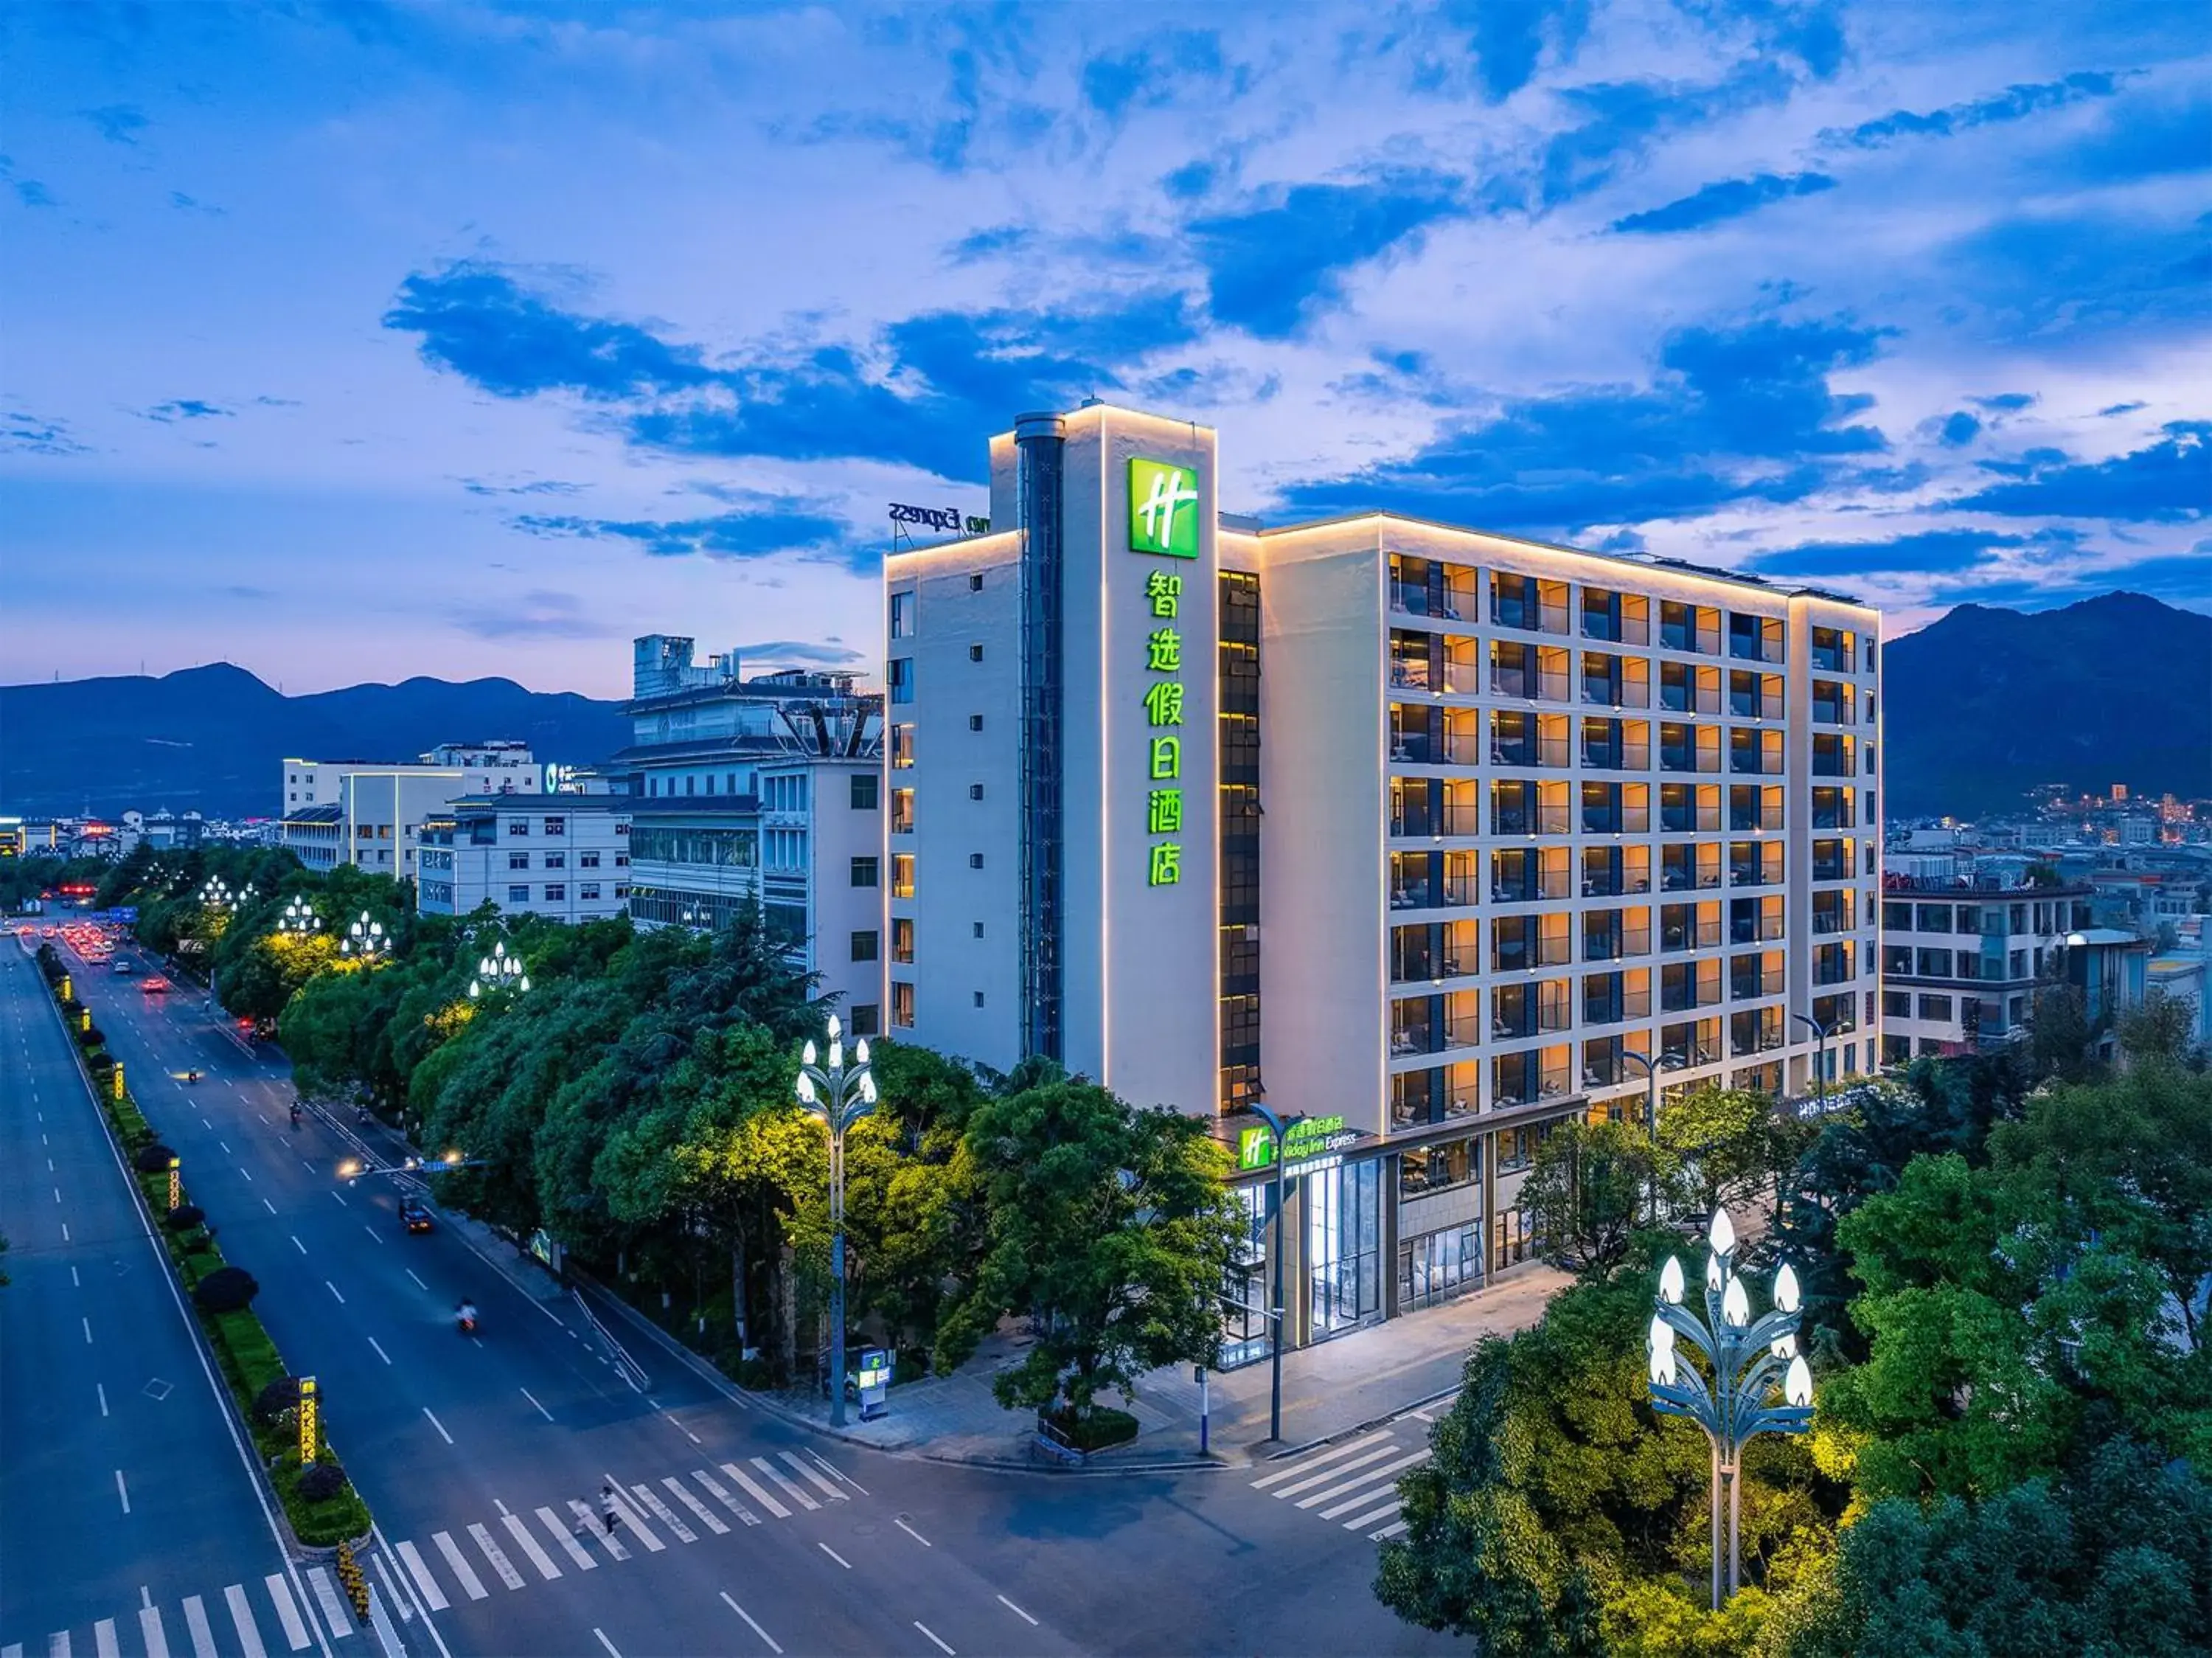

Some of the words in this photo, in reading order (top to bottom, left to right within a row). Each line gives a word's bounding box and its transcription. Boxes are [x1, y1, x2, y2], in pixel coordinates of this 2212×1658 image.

[1145, 570, 1183, 887] 智选假日酒店
[1325, 1134, 1357, 1151] Express
